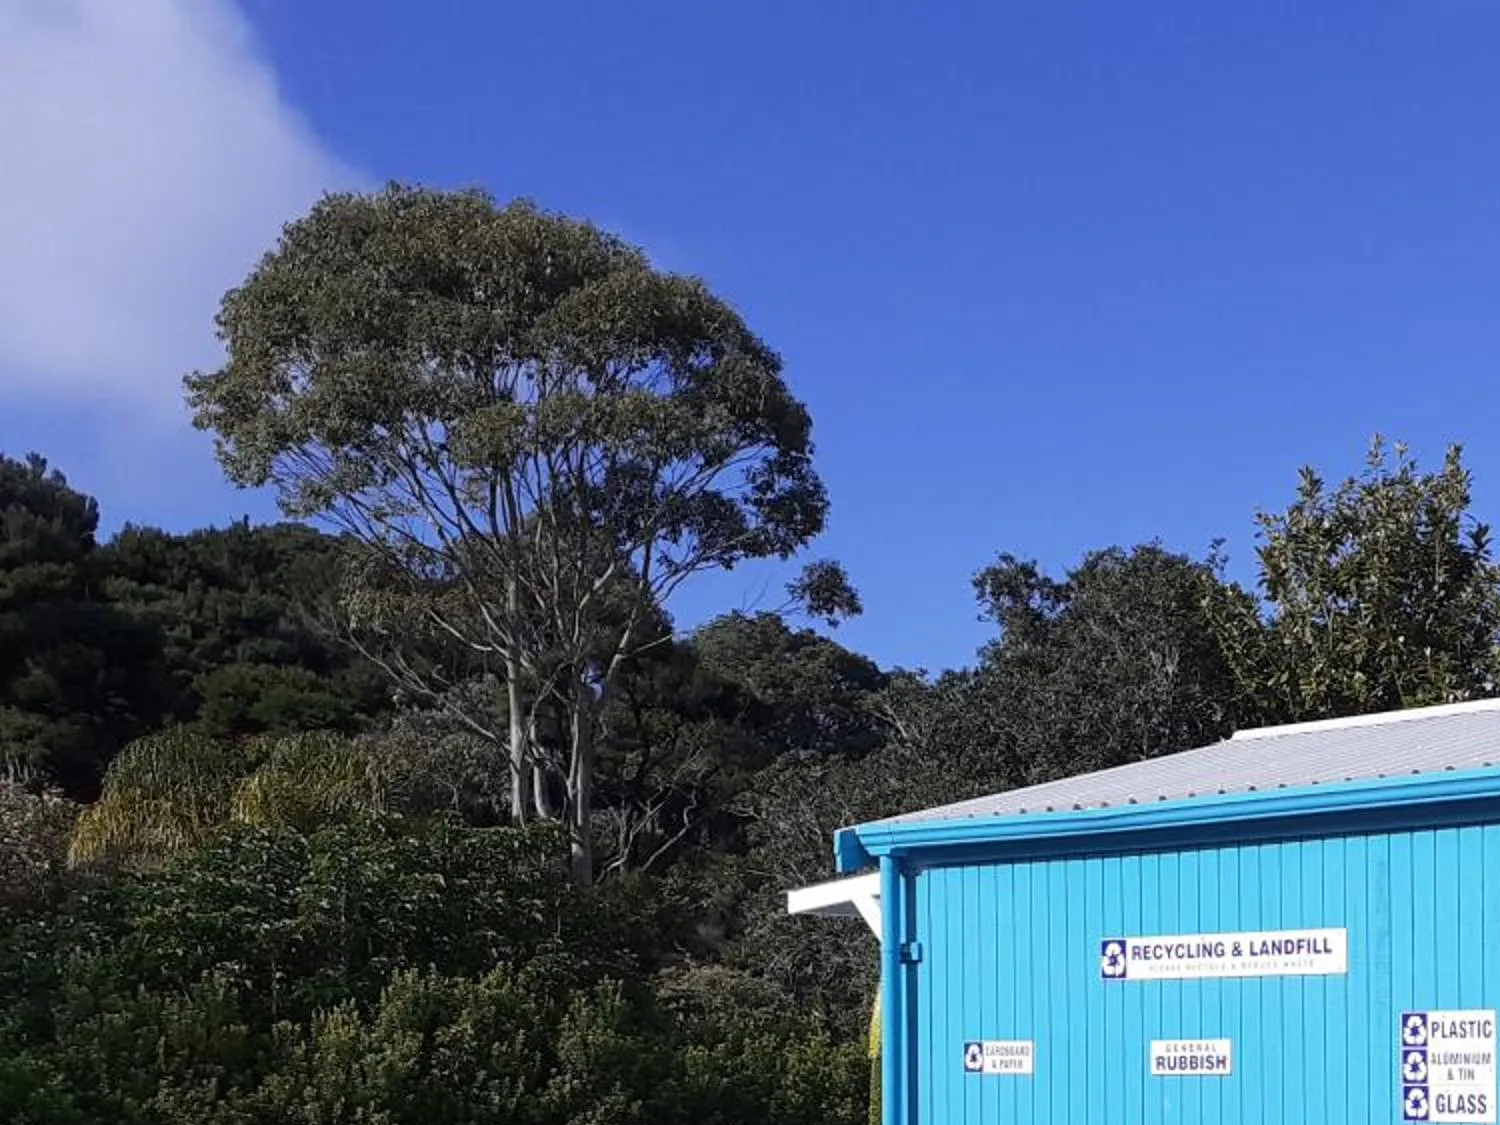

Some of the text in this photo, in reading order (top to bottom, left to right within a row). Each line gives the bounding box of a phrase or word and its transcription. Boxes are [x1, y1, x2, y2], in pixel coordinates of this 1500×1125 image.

[1131, 937, 1333, 961] RECYCLING & LANDFILL
[1431, 1019, 1492, 1039] PLASTIC
[1156, 1055, 1227, 1071] RUBBISH
[1431, 1051, 1492, 1065] ALUMINIUM
[1447, 1067, 1475, 1081] & TIN
[1435, 1093, 1487, 1115] GLASS
